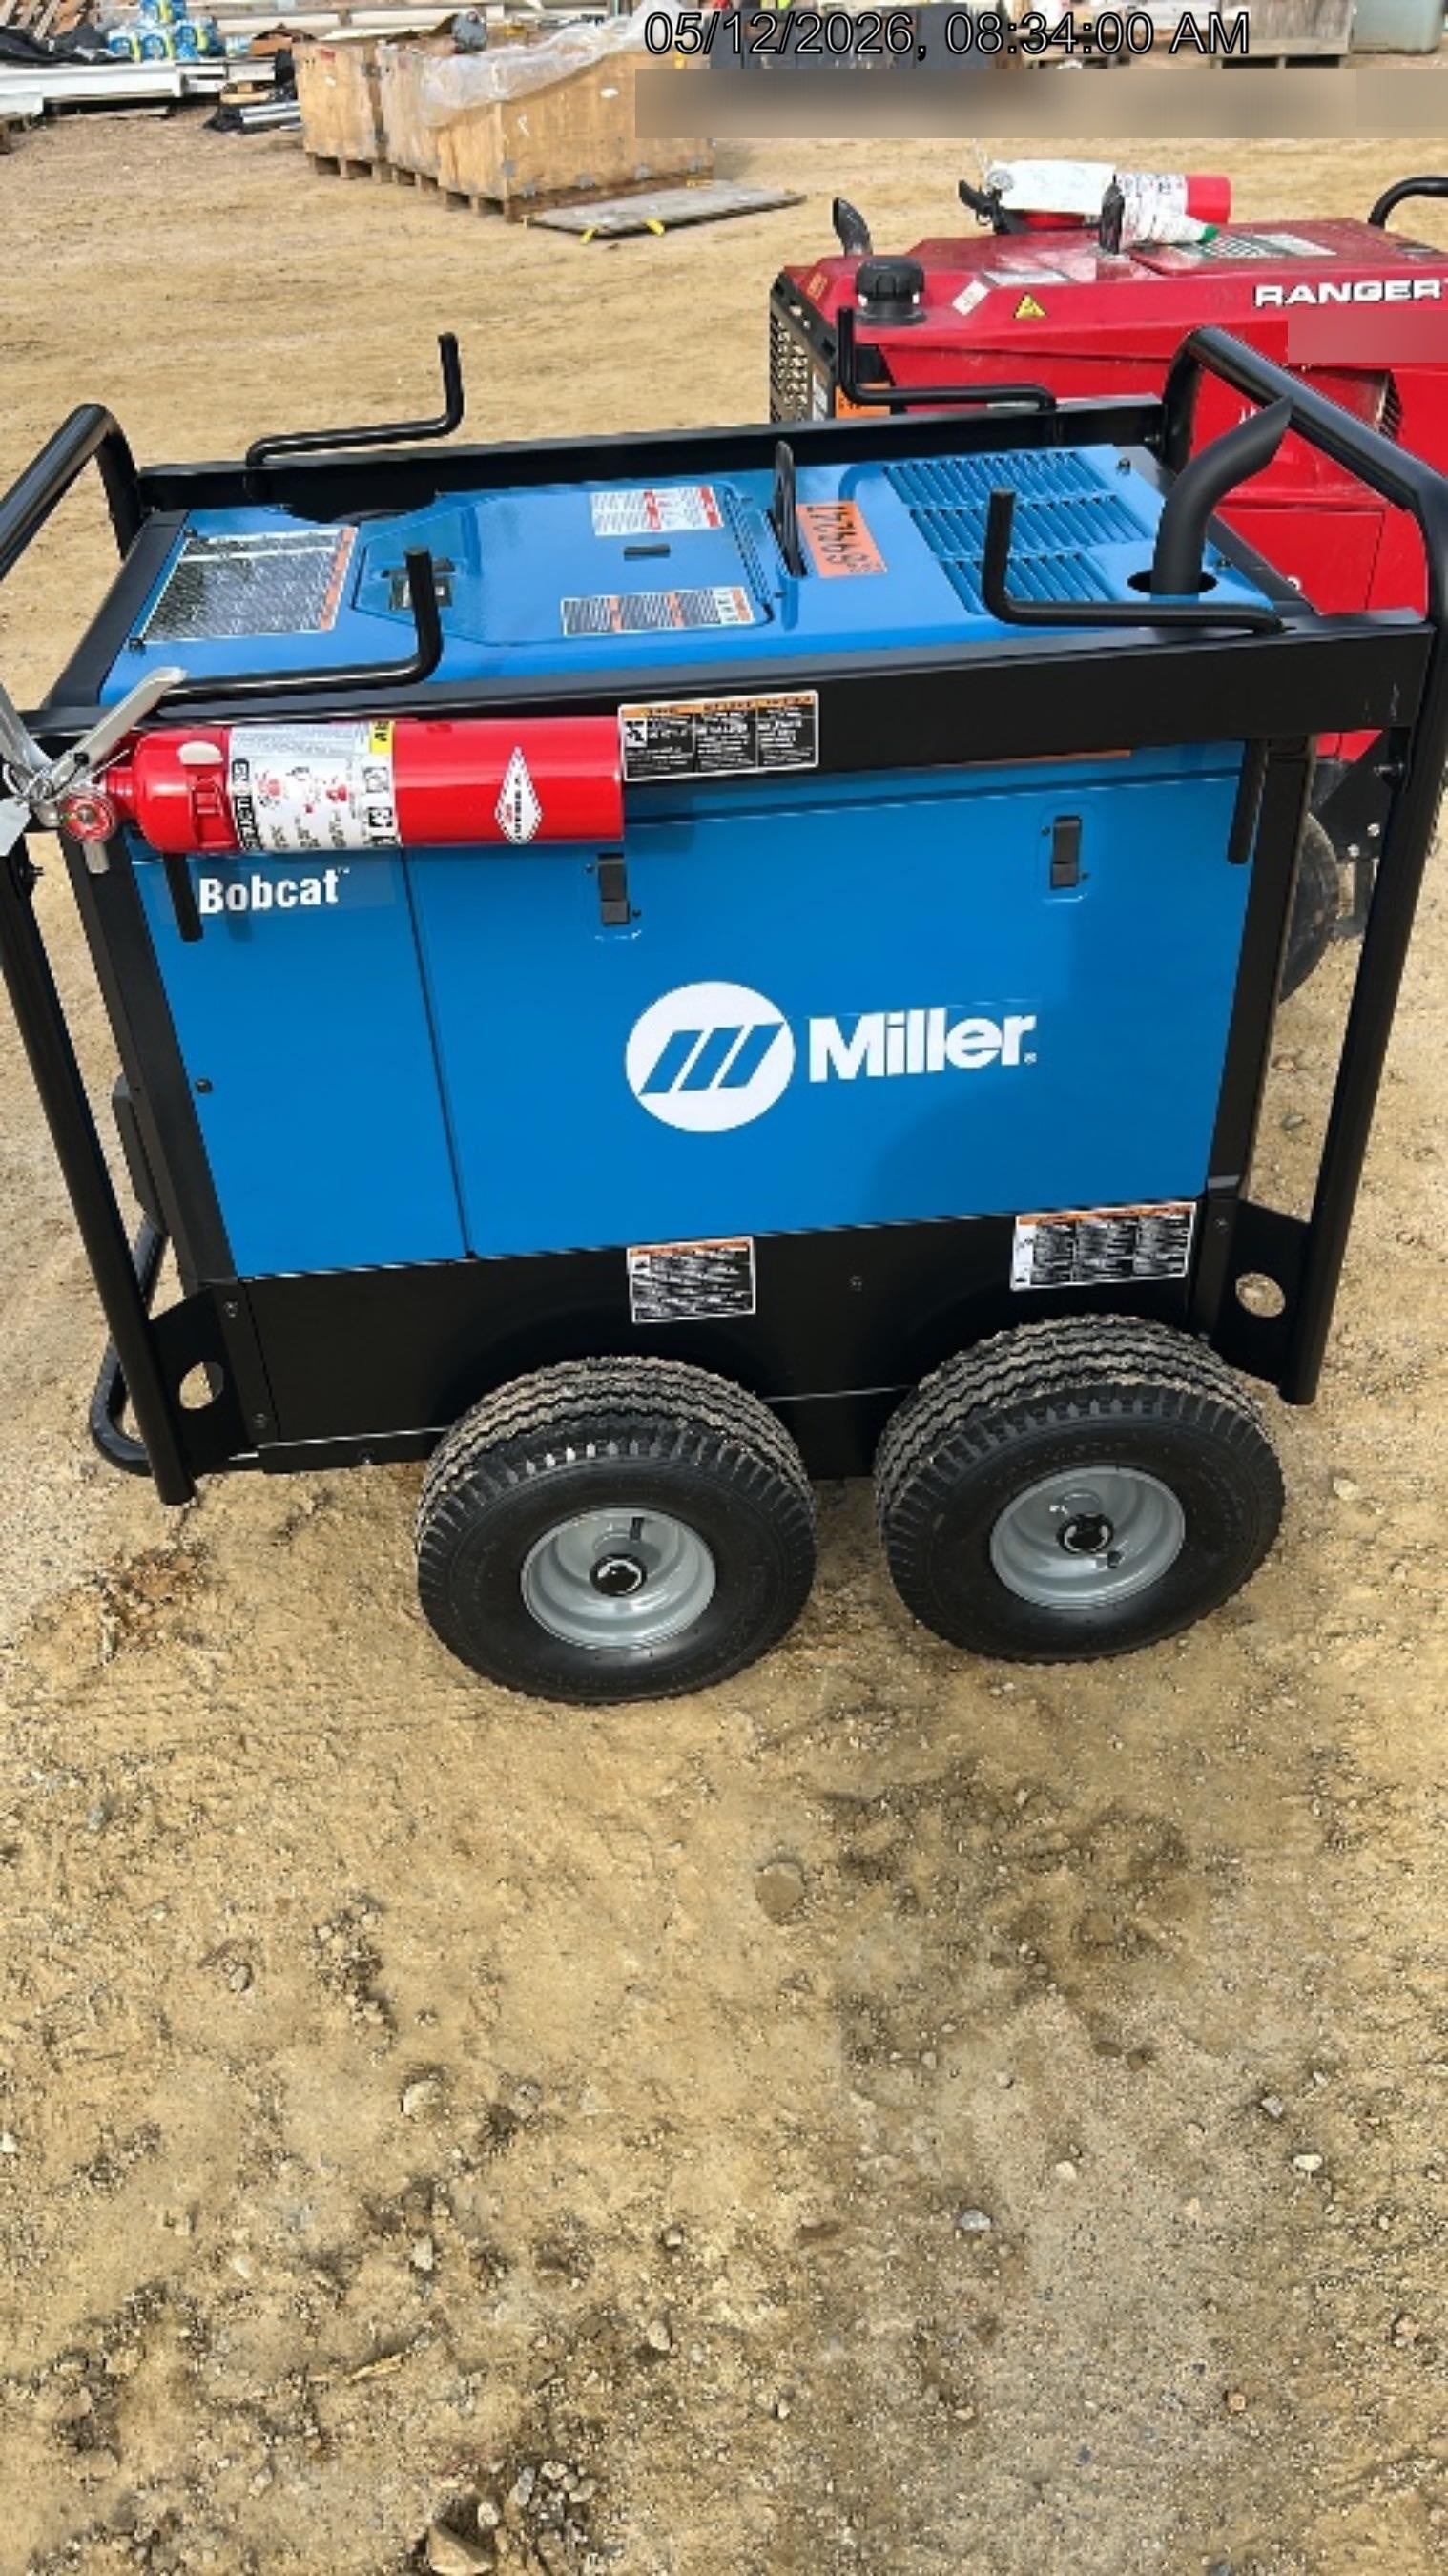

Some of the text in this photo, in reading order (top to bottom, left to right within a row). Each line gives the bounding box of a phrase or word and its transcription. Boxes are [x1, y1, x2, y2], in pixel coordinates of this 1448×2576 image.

[1254, 280, 1441, 307] RANGER
[198, 869, 339, 915] Bobcat
[809, 1007, 1037, 1083] Miller
